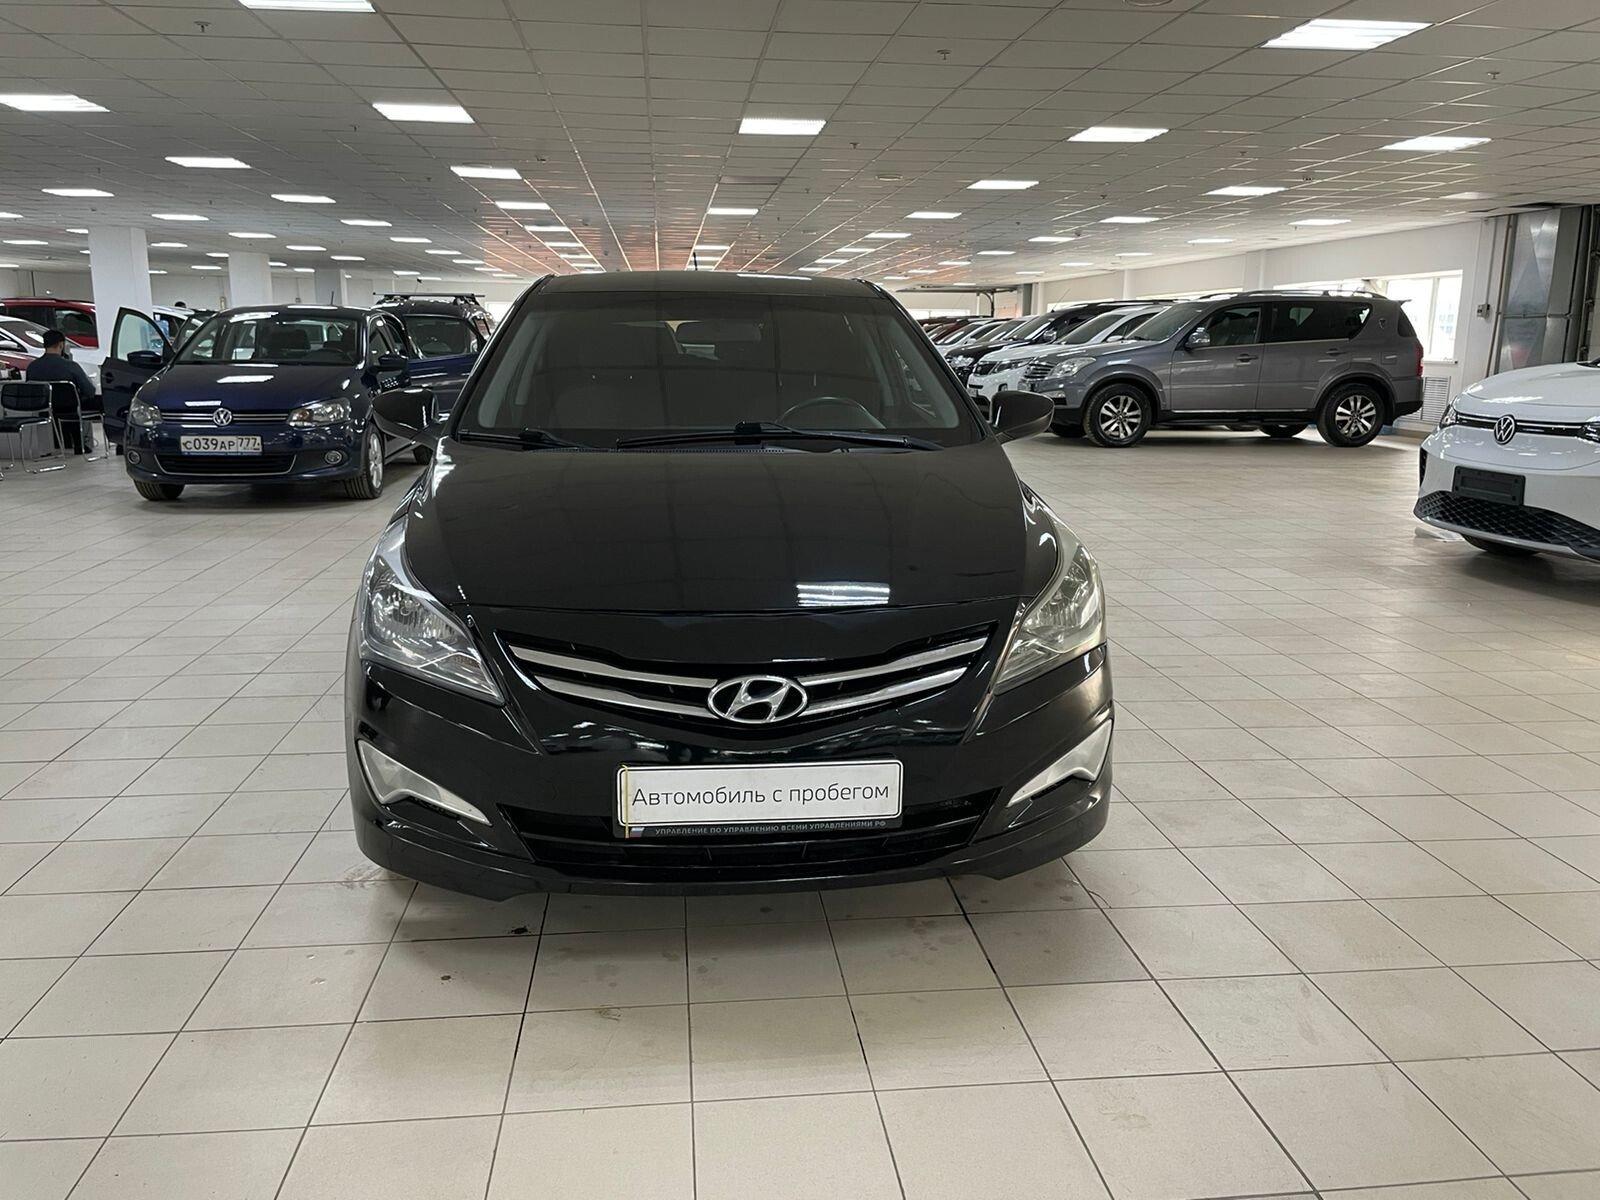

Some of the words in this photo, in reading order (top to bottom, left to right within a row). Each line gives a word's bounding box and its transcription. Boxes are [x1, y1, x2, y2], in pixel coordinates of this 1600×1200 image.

[632, 786, 766, 806] Автомобиль
[773, 789, 782, 802] с
[790, 783, 889, 805] пробегом
[655, 827, 708, 835] УПРАВЛЕНИЕ
[723, 824, 779, 834] УПРАВЛЕНИЮ
[781, 823, 808, 832] ВСЕМИ
[809, 820, 873, 831] УПРАВЛЕНИЯМИ
[875, 820, 886, 828] РФ
